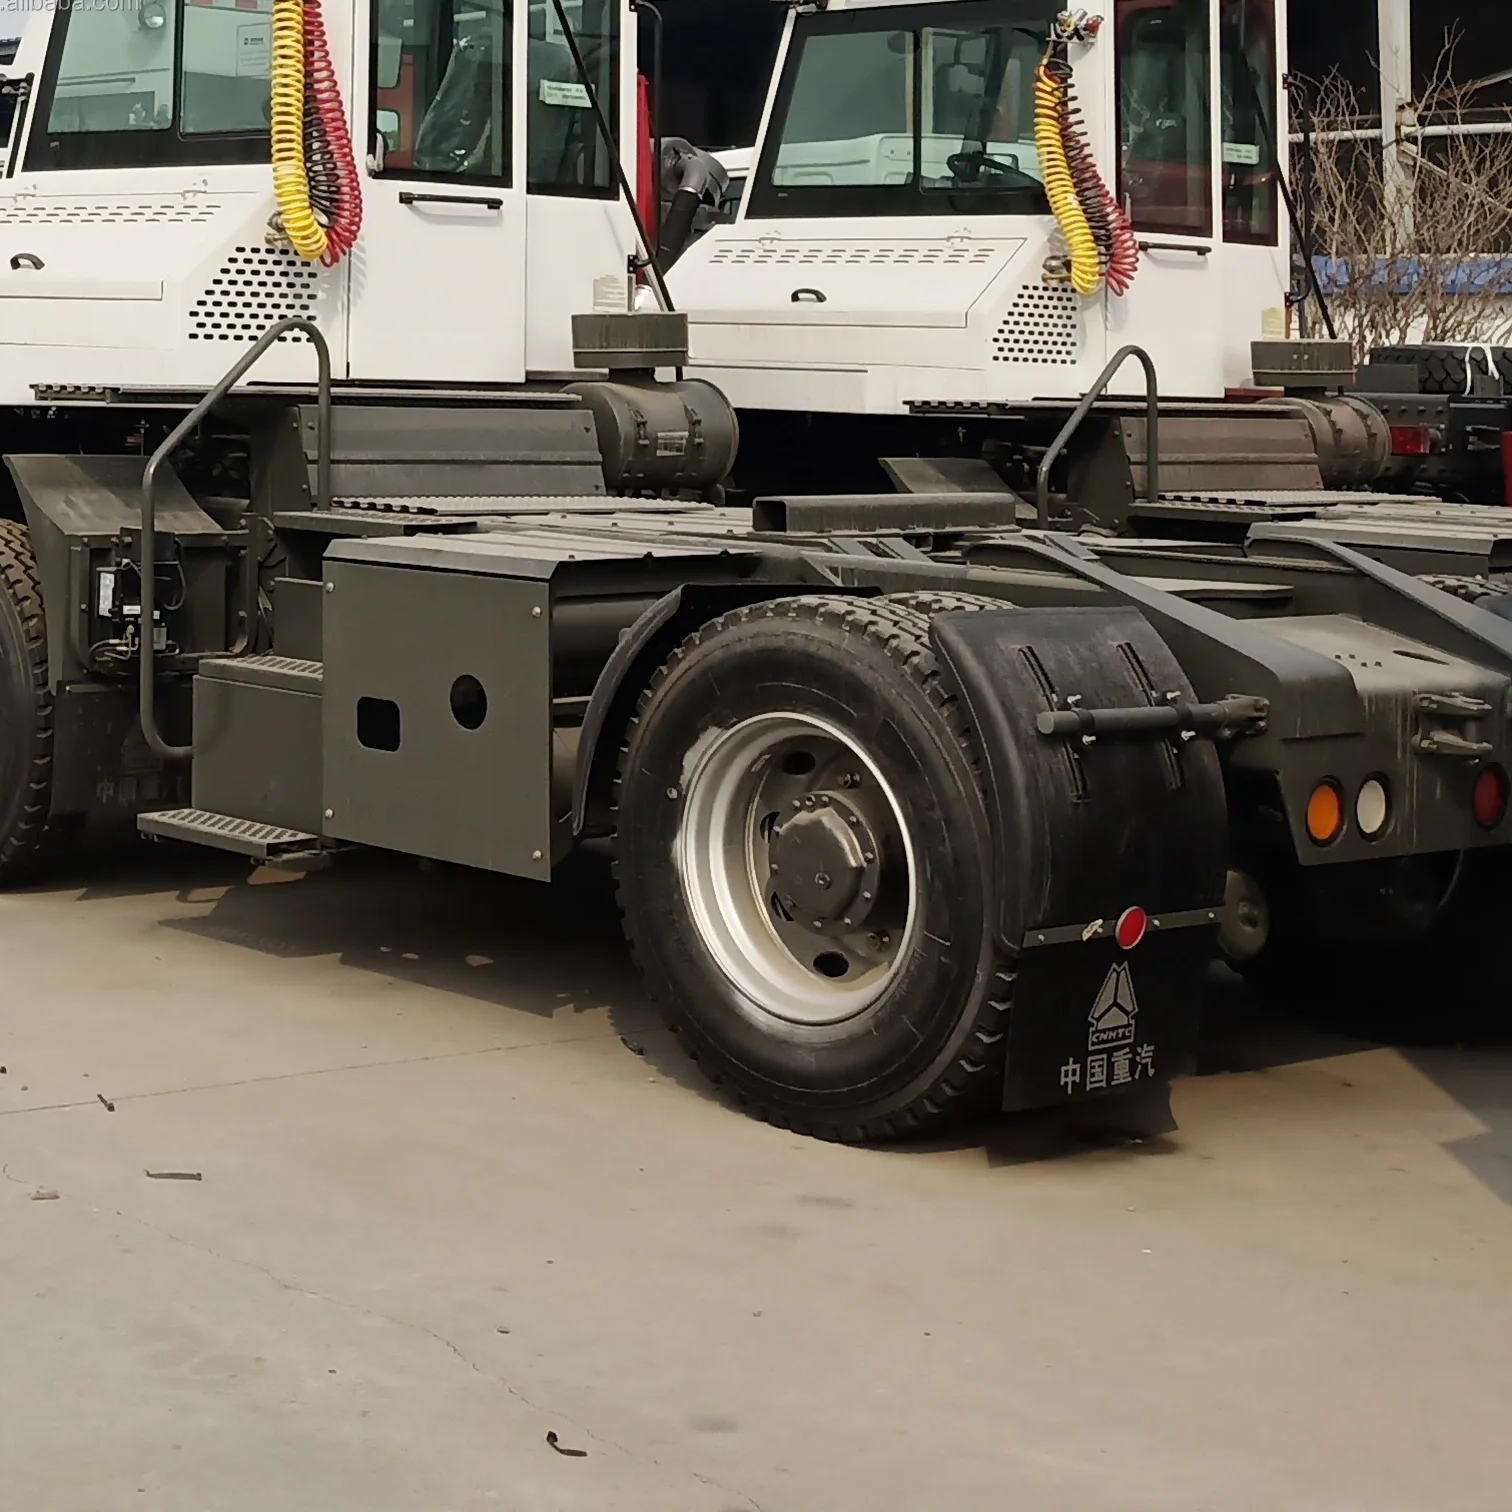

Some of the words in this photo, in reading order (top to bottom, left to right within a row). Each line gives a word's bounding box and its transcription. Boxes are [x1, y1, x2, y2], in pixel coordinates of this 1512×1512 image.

[1091, 1027, 1131, 1043] CNHTC
[1059, 1042, 1156, 1095] 中国重汽
